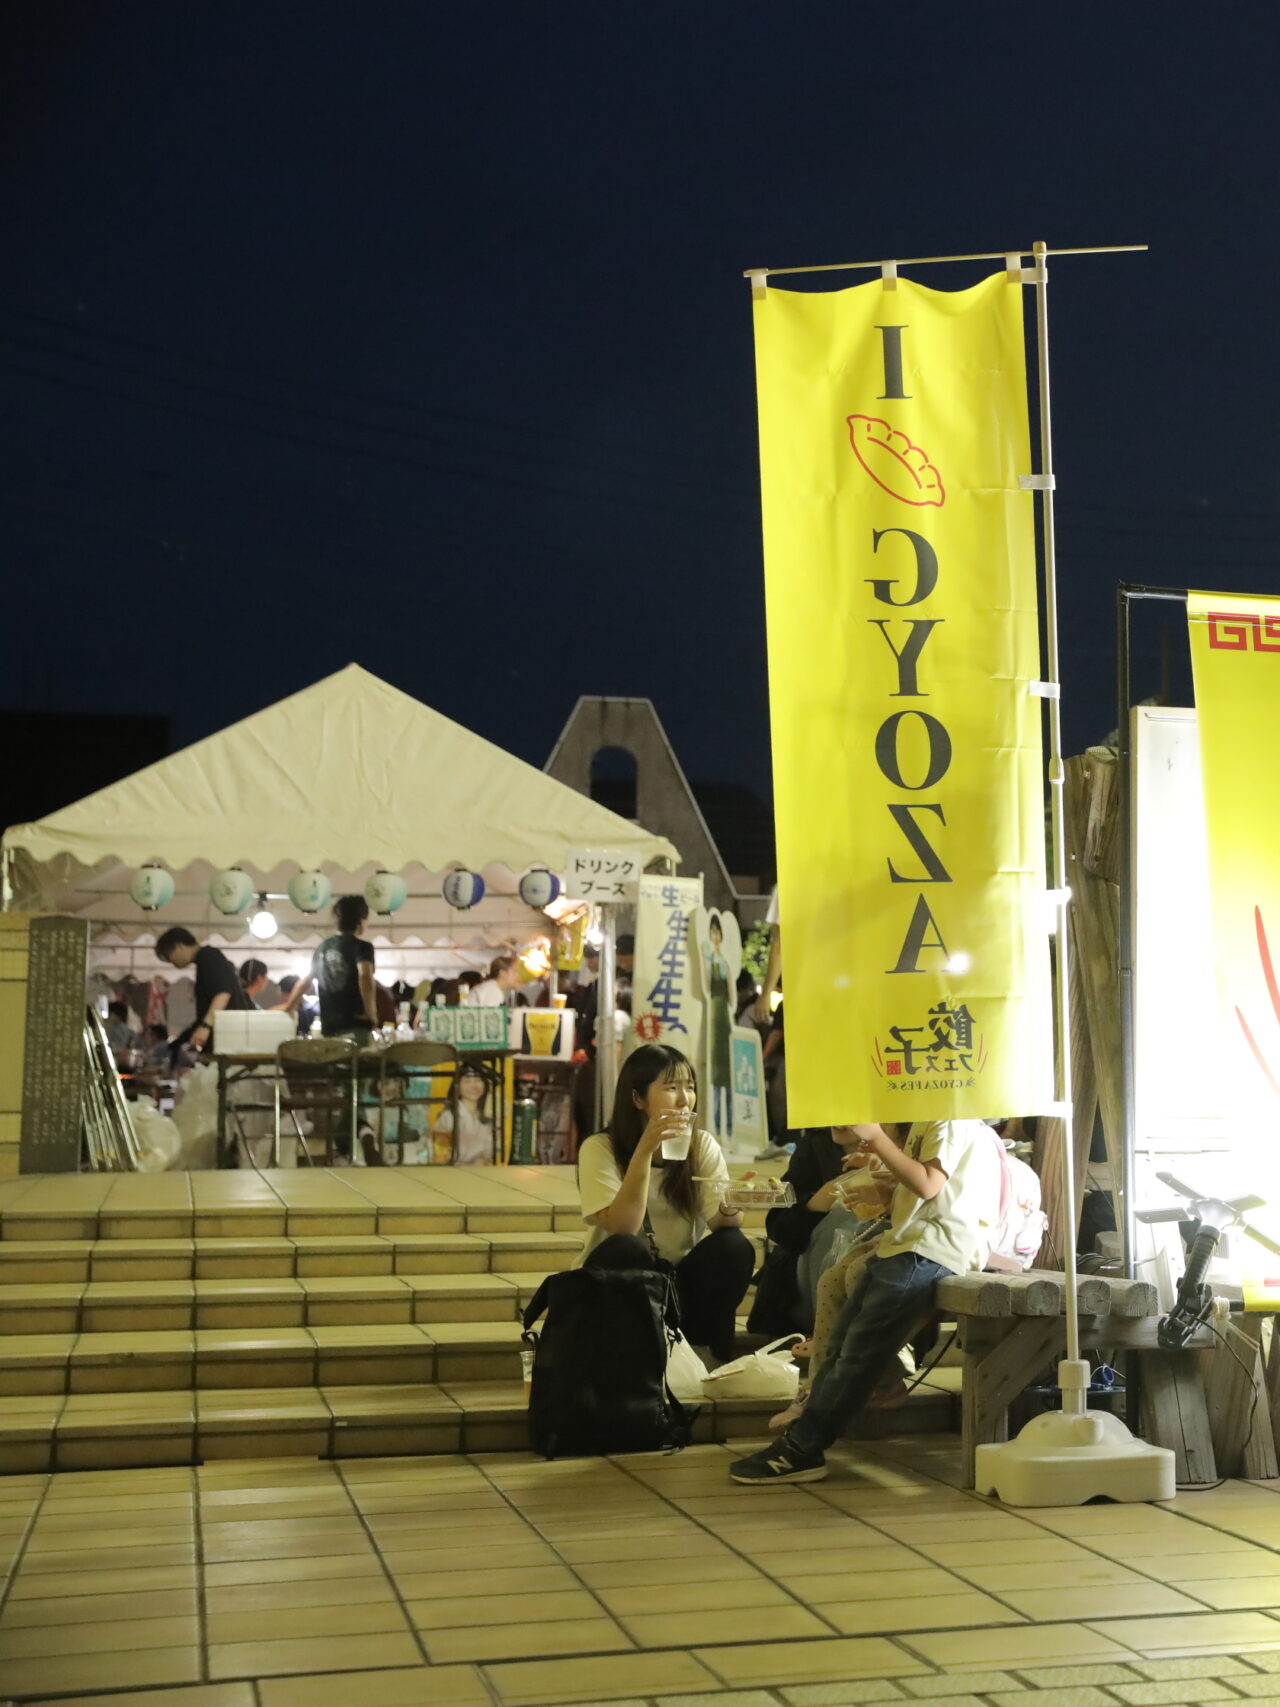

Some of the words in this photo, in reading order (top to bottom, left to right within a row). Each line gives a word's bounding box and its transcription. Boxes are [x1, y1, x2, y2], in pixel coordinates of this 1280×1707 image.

[575, 858, 634, 875] ドリンク
[581, 880, 625, 896] ブース
